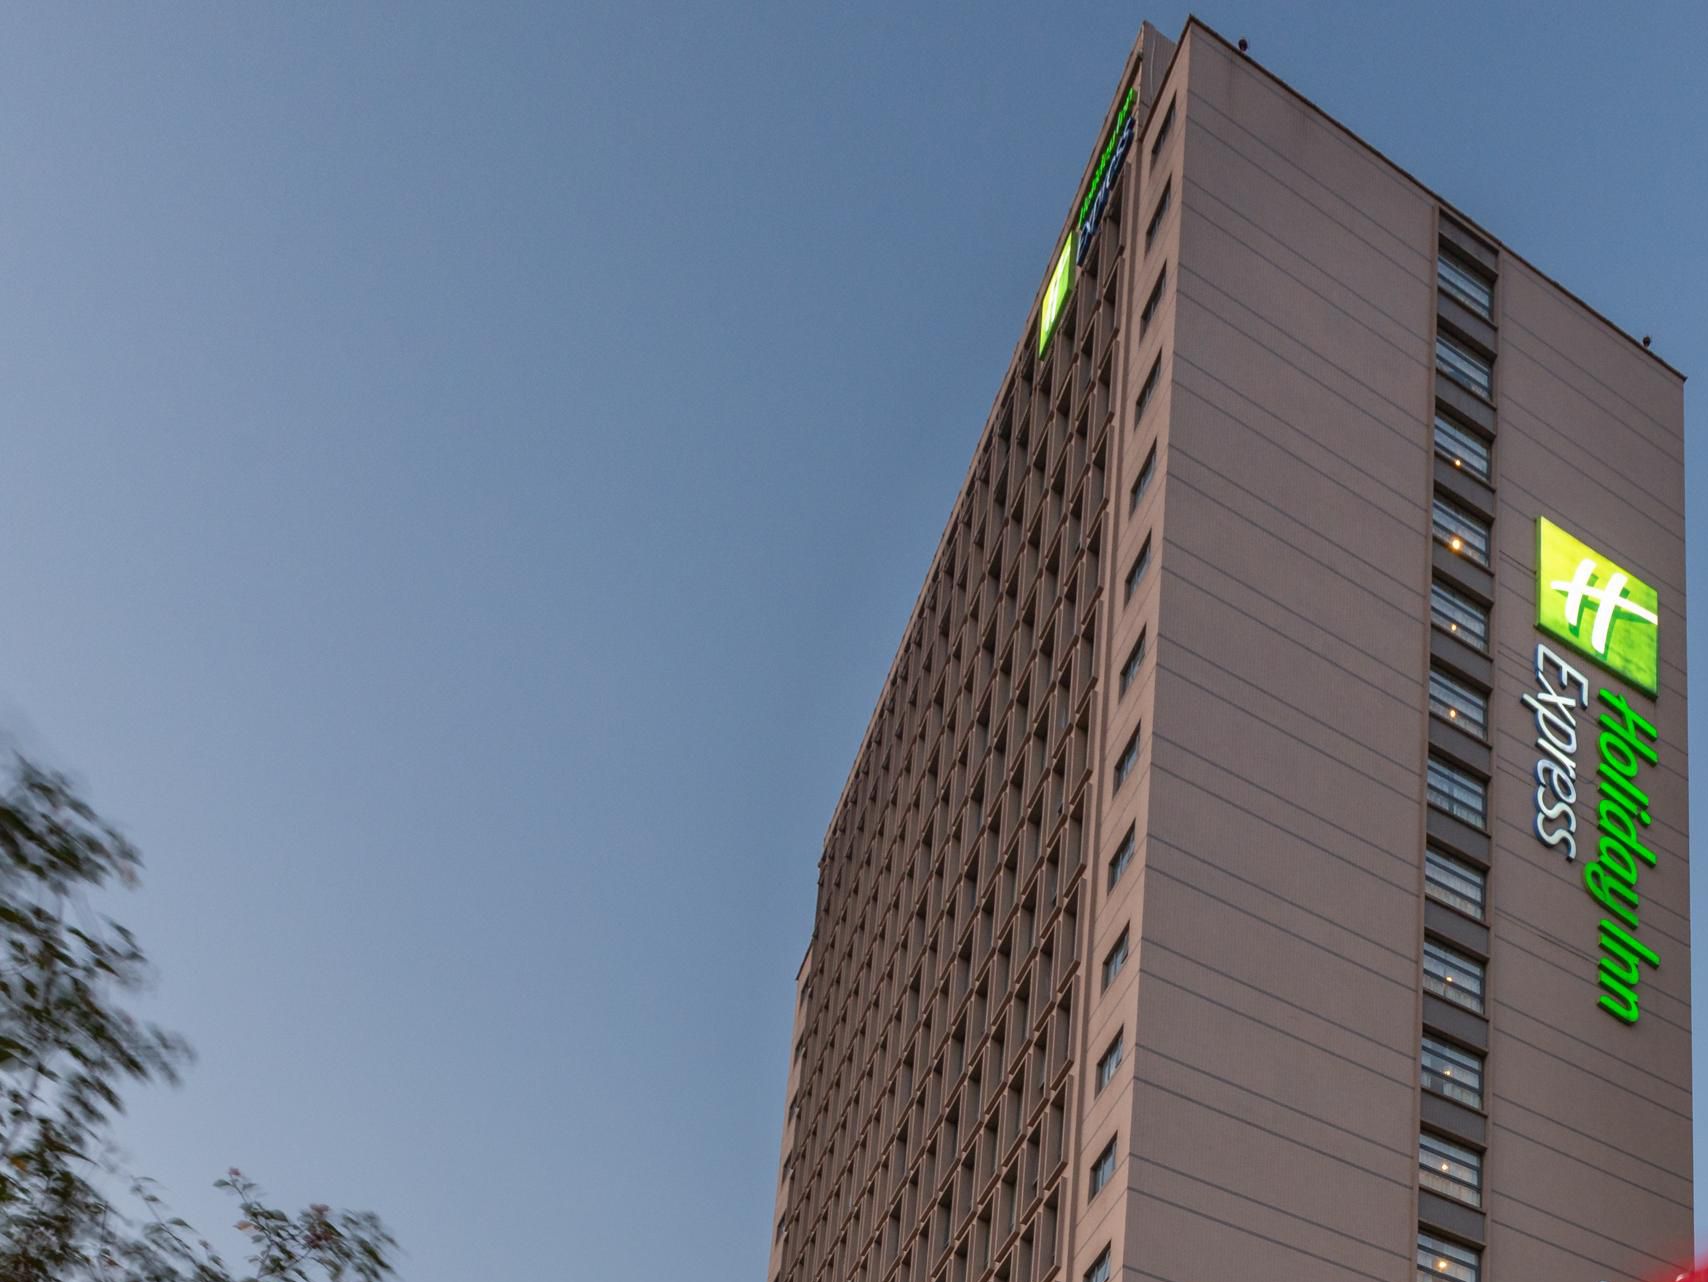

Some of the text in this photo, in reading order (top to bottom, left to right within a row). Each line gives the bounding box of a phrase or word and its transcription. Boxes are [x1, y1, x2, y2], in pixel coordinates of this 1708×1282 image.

[1520, 643, 1588, 861] Express
[1584, 687, 1661, 1025] Holiday Inn
